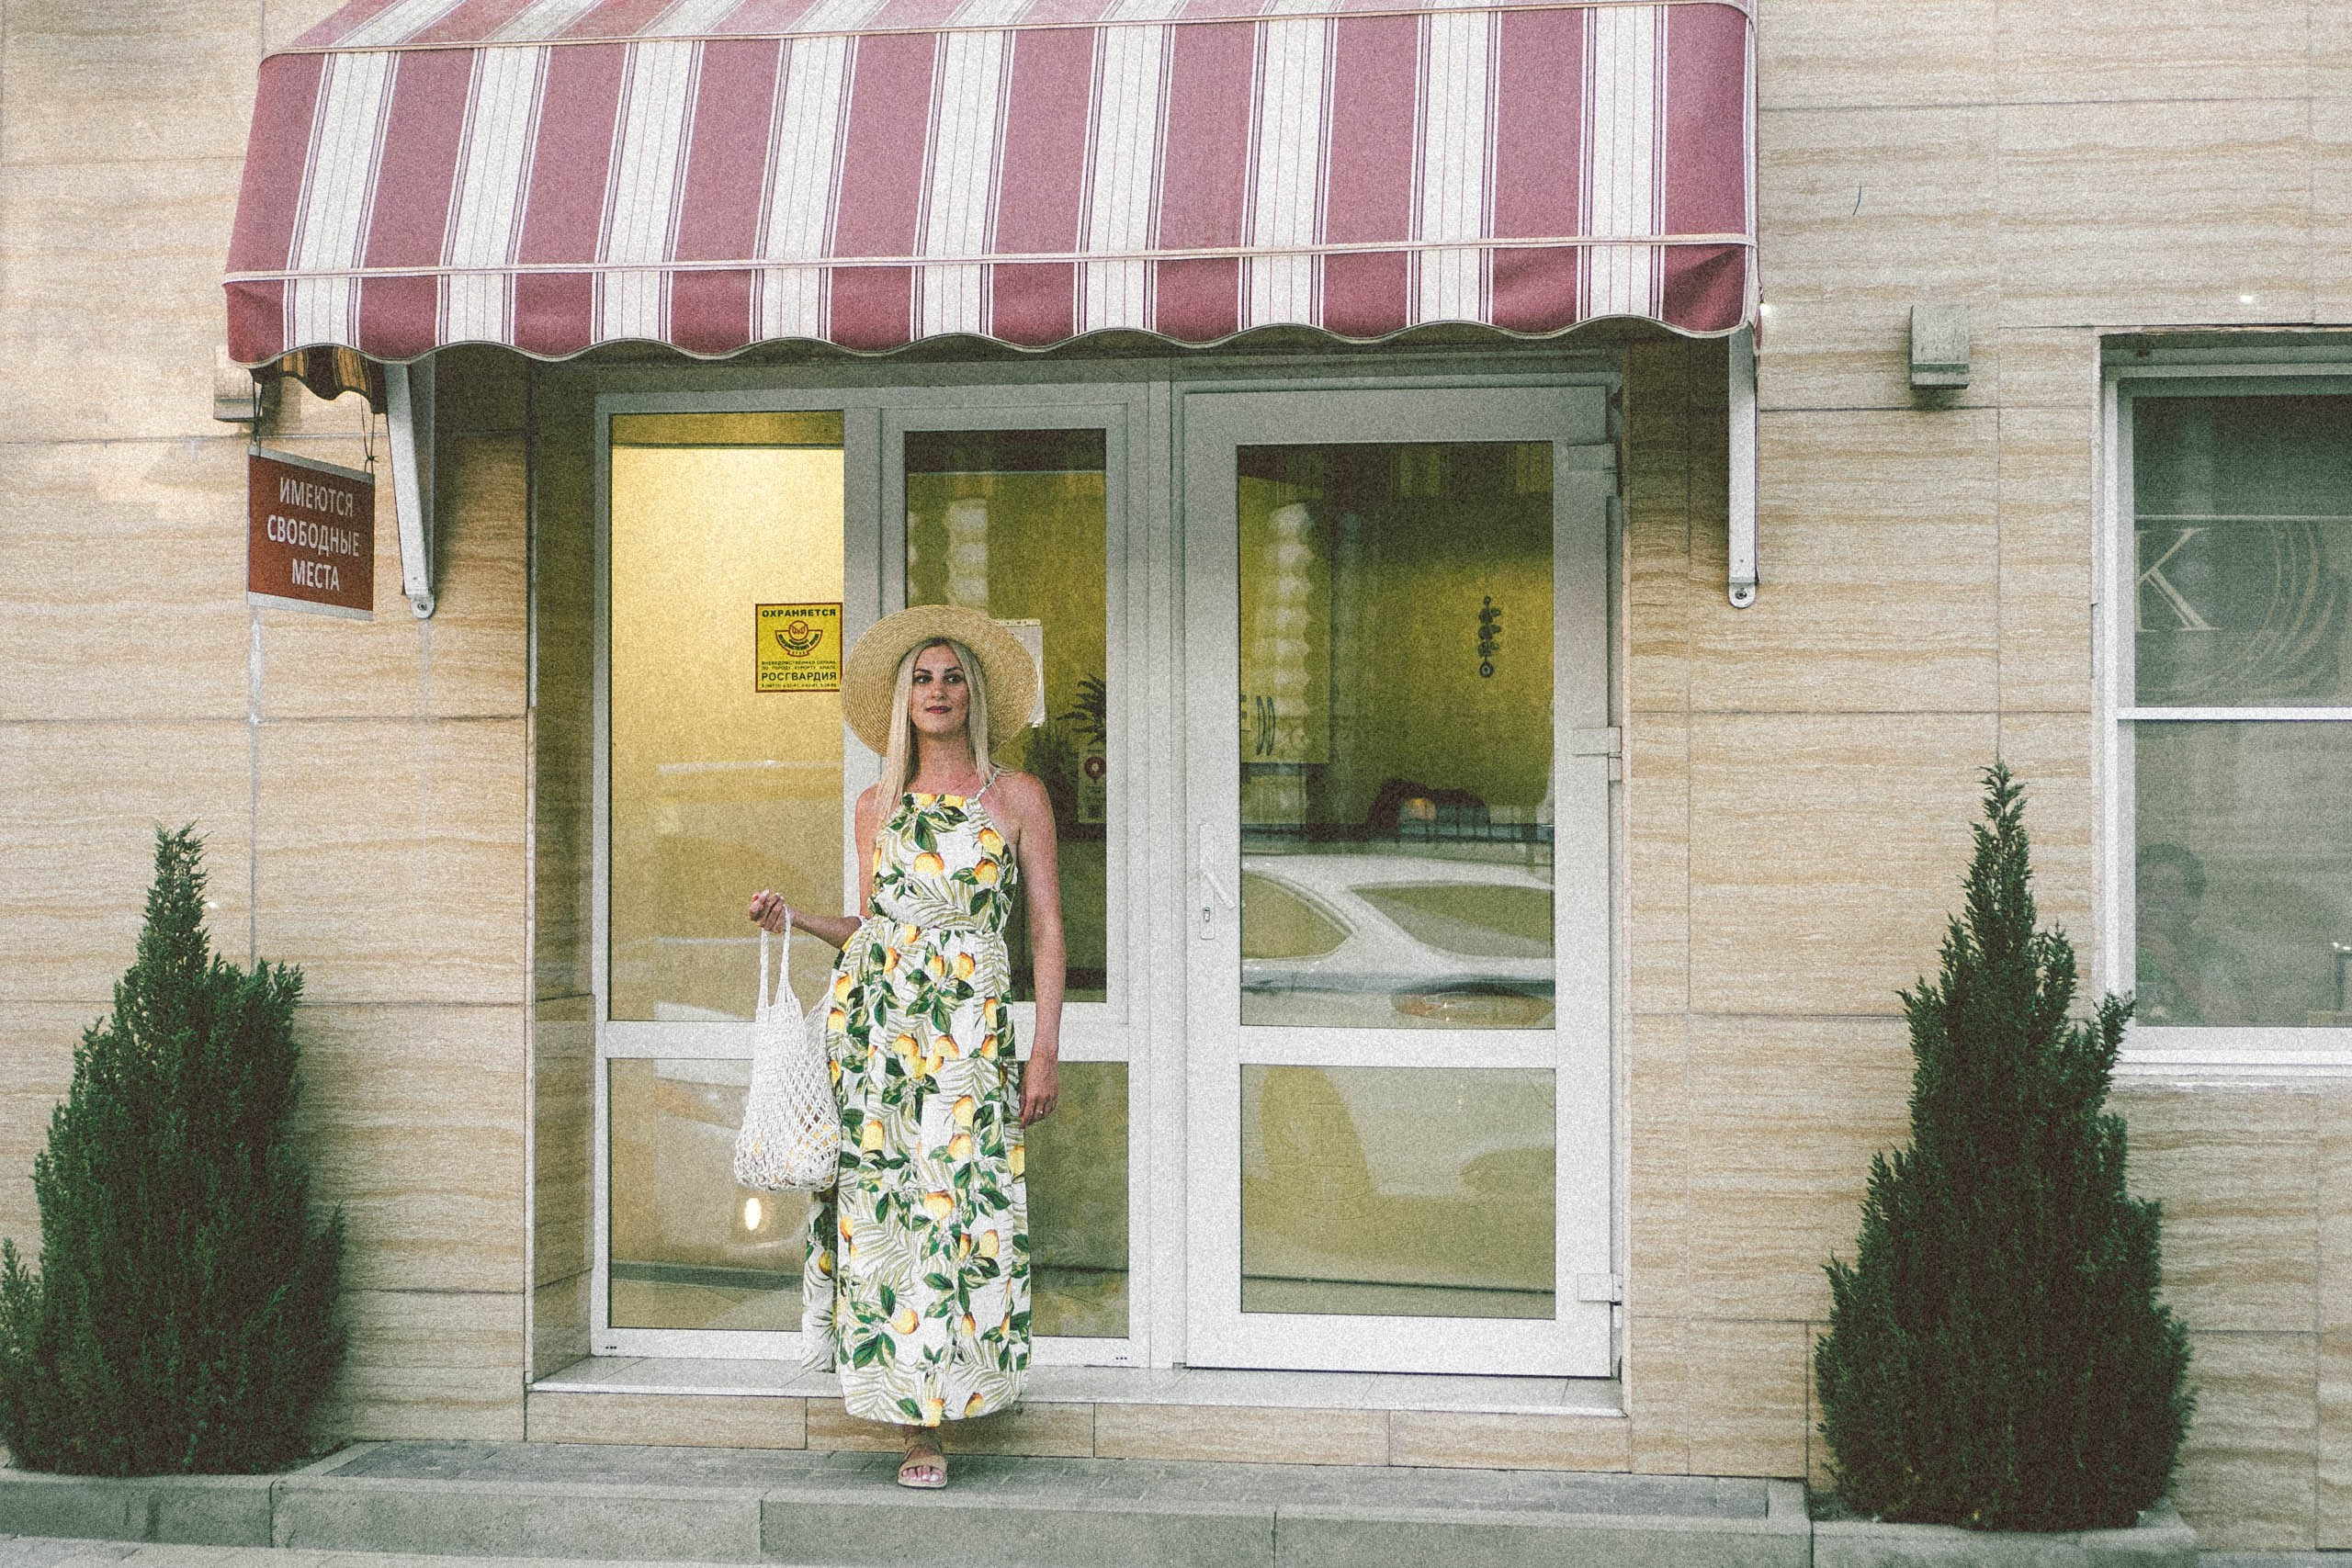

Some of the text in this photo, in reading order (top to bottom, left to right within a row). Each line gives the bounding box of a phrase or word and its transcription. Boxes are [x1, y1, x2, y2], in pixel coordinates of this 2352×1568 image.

[279, 477, 354, 517] ИМЕЮТСЯ
[266, 514, 360, 558] СВОБОДНЫЕ
[291, 558, 340, 592] МЕСТА
[762, 608, 836, 617] ОХРАНЯЕТСЯ
[762, 672, 836, 682] РОСГВАРДИЯ
